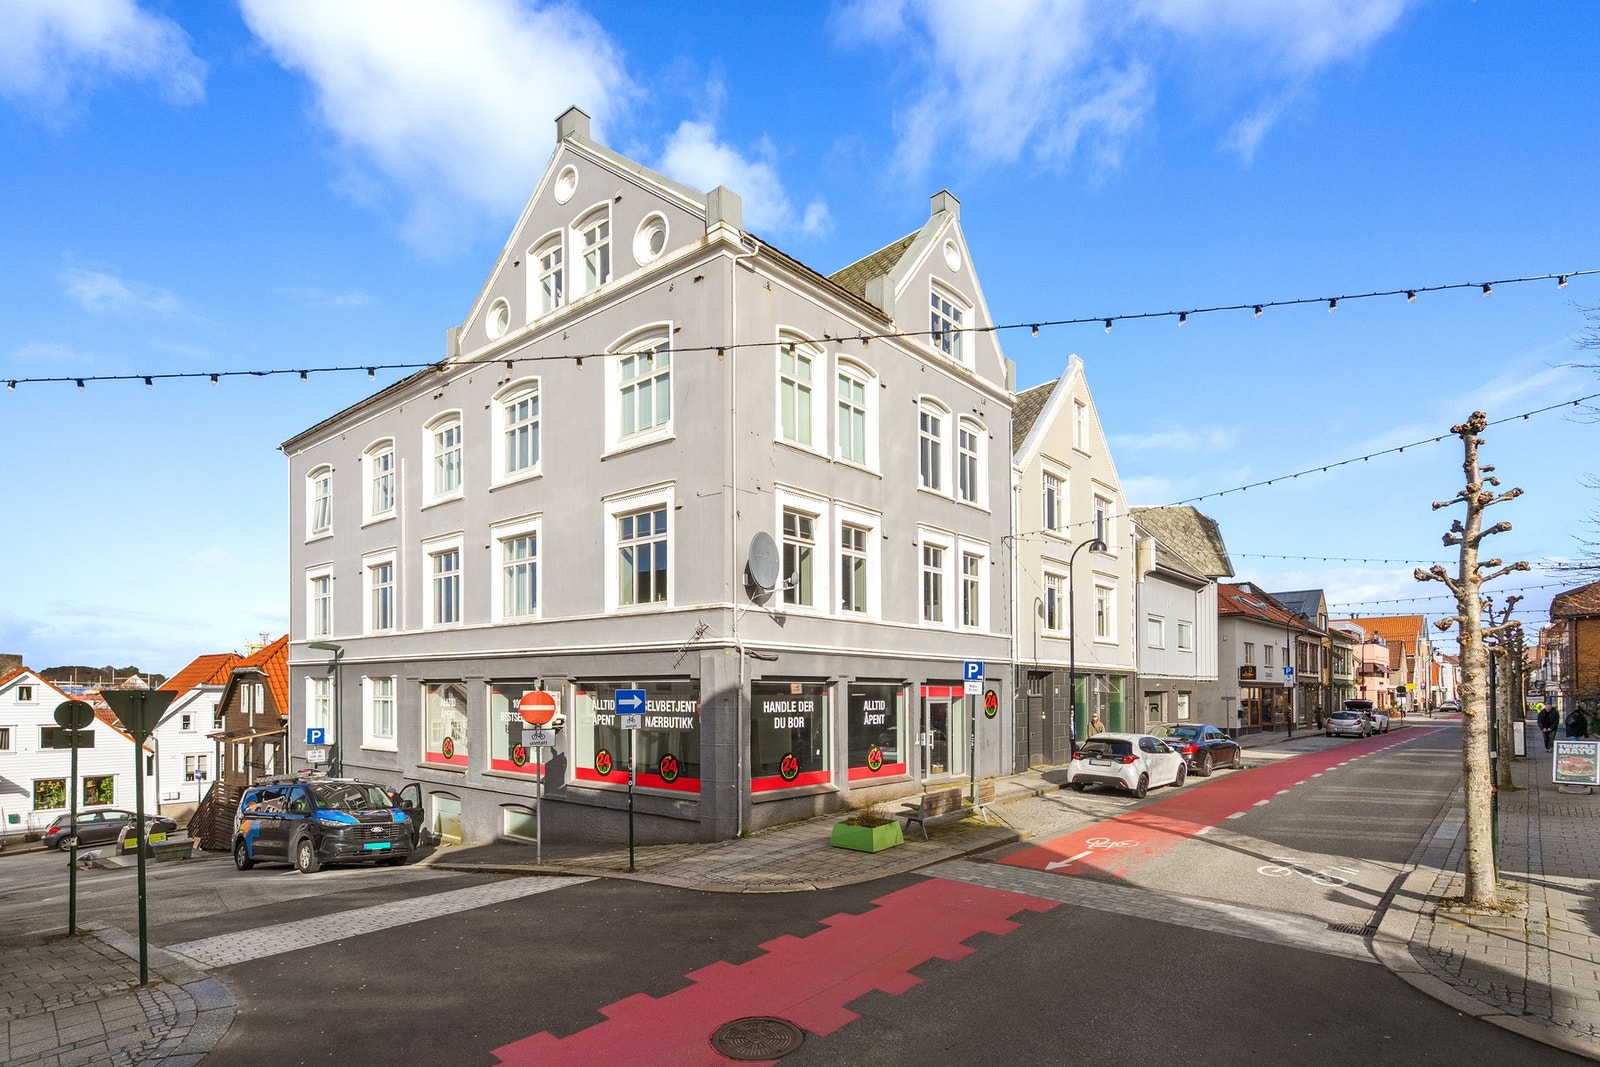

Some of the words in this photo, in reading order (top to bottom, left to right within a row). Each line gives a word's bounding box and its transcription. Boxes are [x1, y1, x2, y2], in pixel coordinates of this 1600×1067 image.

[968, 664, 978, 678] P
[592, 700, 615, 710] ALLTID
[763, 701, 797, 713] HANDLE
[798, 700, 814, 712] DER
[863, 700, 886, 711] ALLTID
[986, 696, 996, 708] 24
[645, 716, 694, 729] NÆRBUTIKK
[774, 717, 786, 729] DU
[788, 716, 805, 728] BOR
[863, 713, 886, 725] ÅPENT
[312, 730, 322, 743] P
[444, 742, 454, 750] 24
[514, 747, 526, 758] 24
[870, 752, 882, 762] 24
[598, 754, 612, 766] 24
[662, 758, 676, 772] 24
[783, 757, 798, 772] 24
